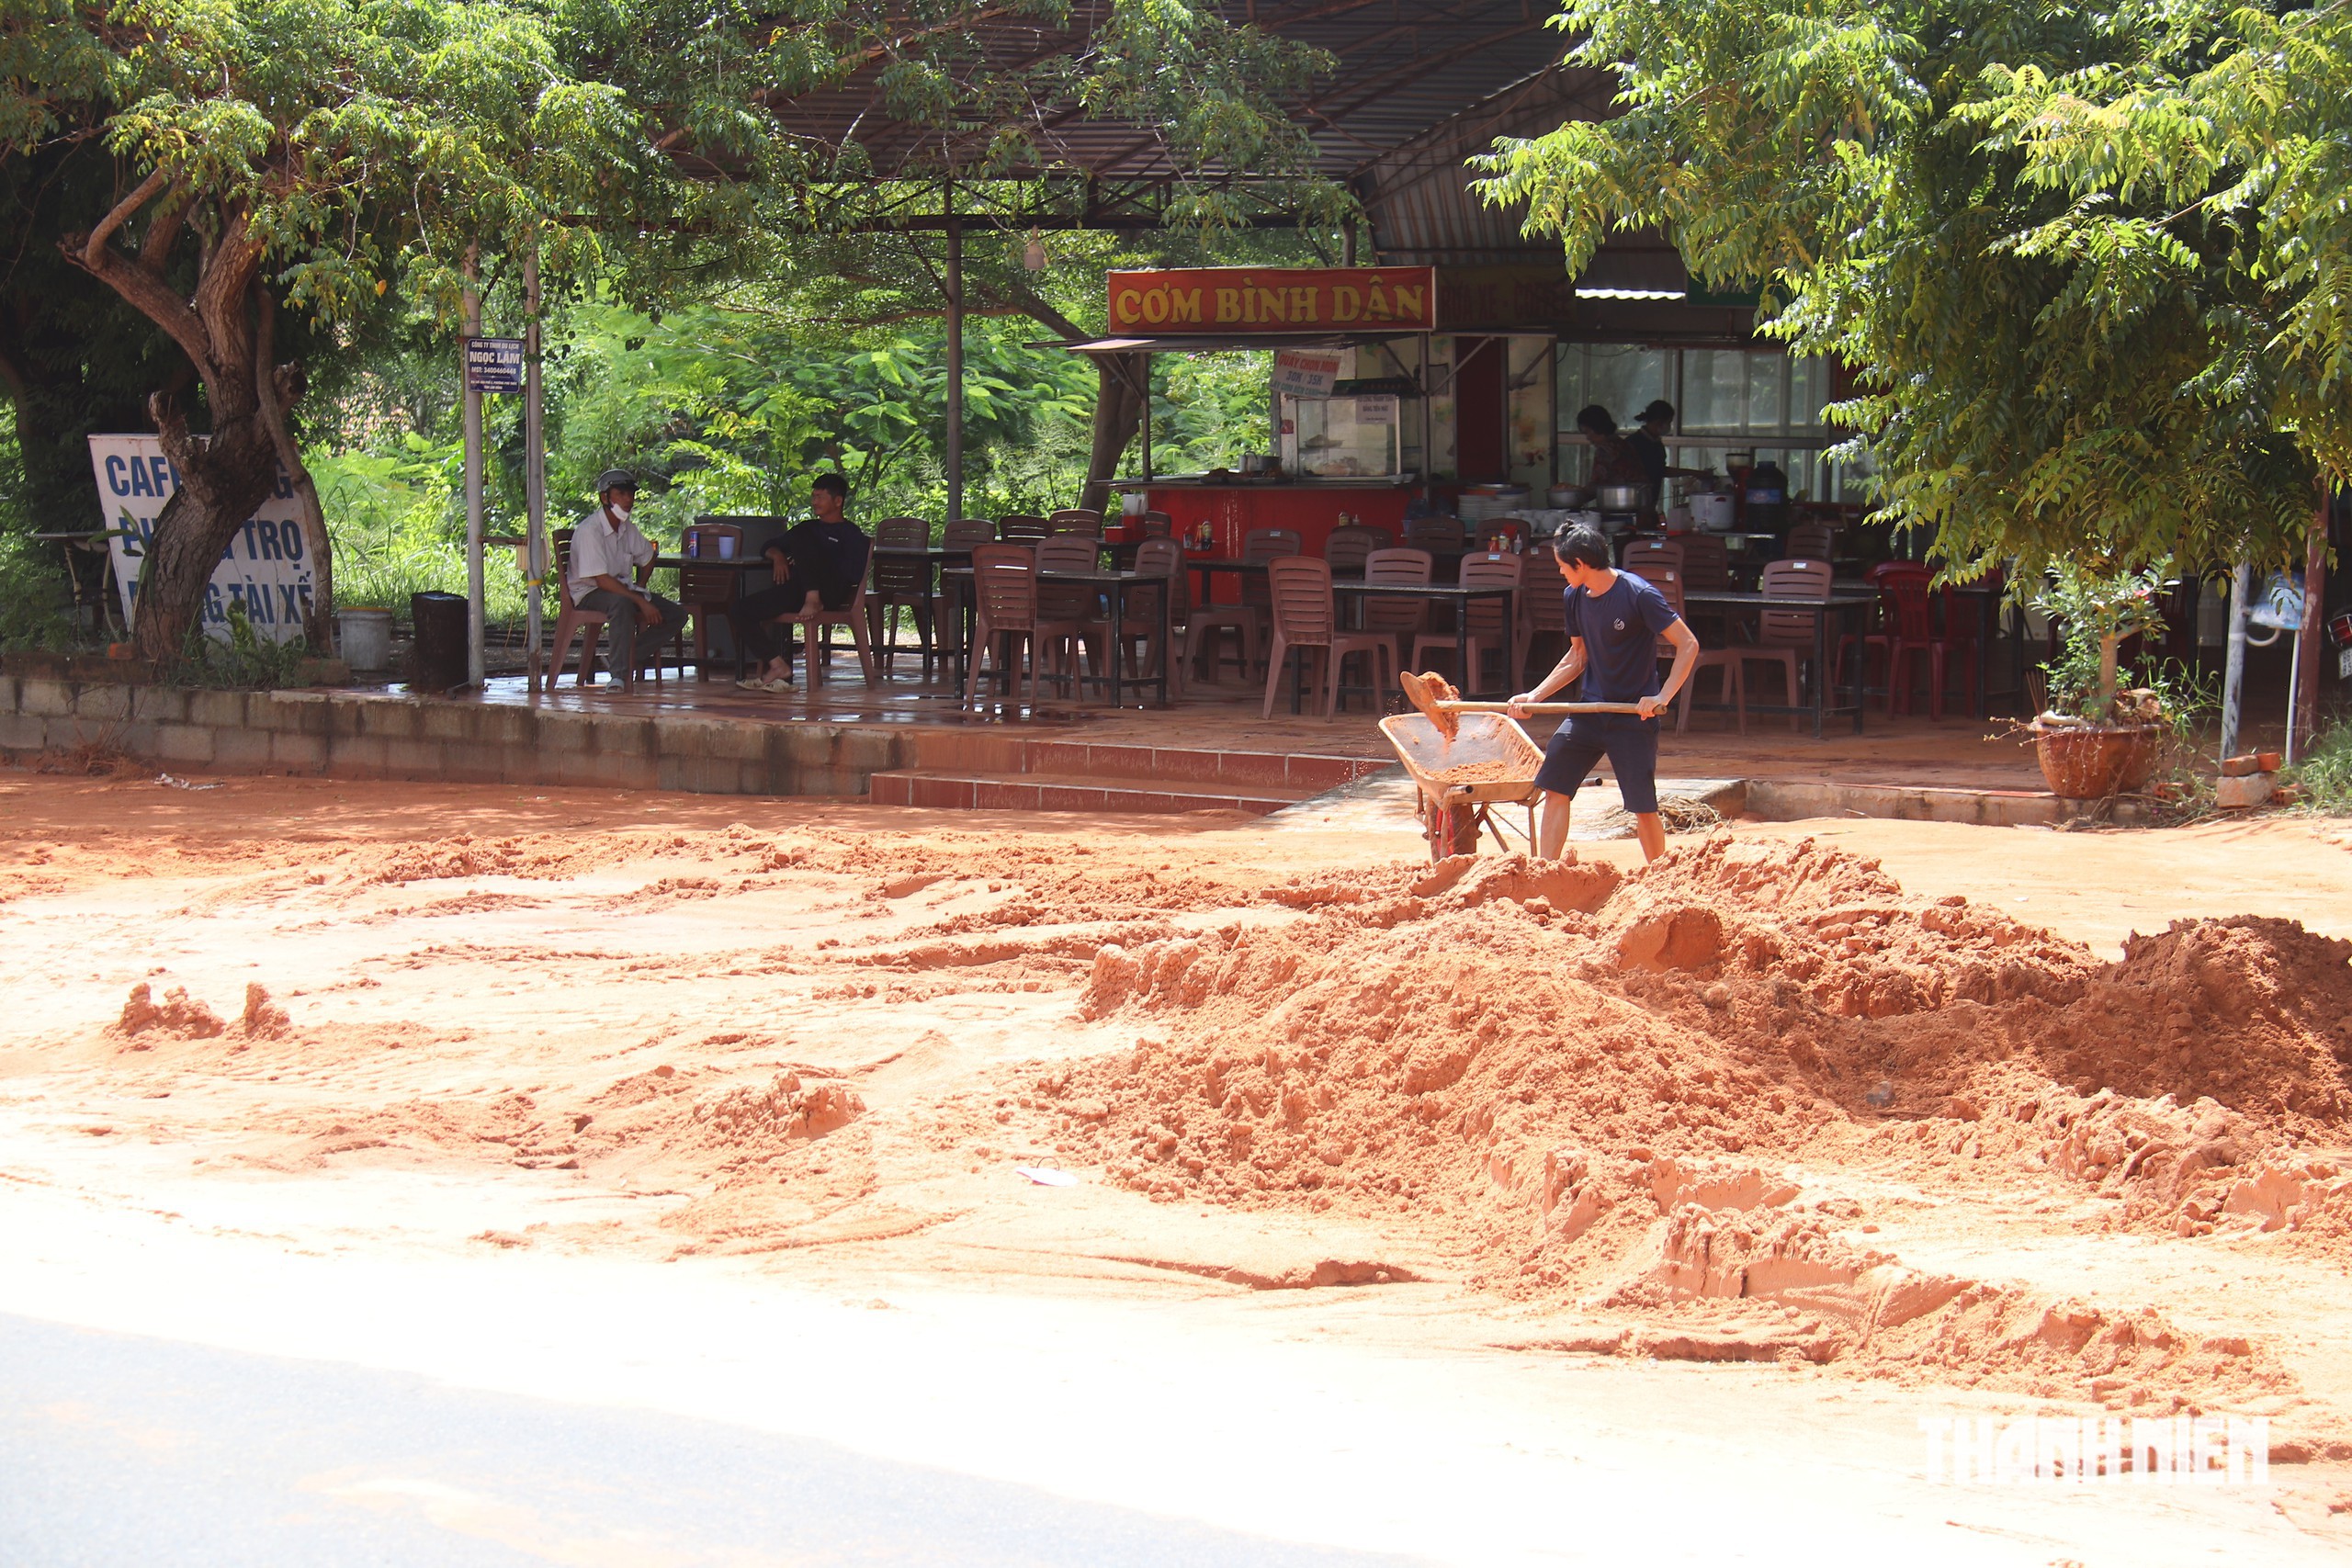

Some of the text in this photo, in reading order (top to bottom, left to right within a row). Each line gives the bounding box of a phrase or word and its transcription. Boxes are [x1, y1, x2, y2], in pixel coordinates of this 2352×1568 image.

[1115, 275, 1425, 324] CƠM BÌNH DÂN
[469, 351, 520, 365] NGỌC LÂM
[243, 519, 303, 570] TRỌ
